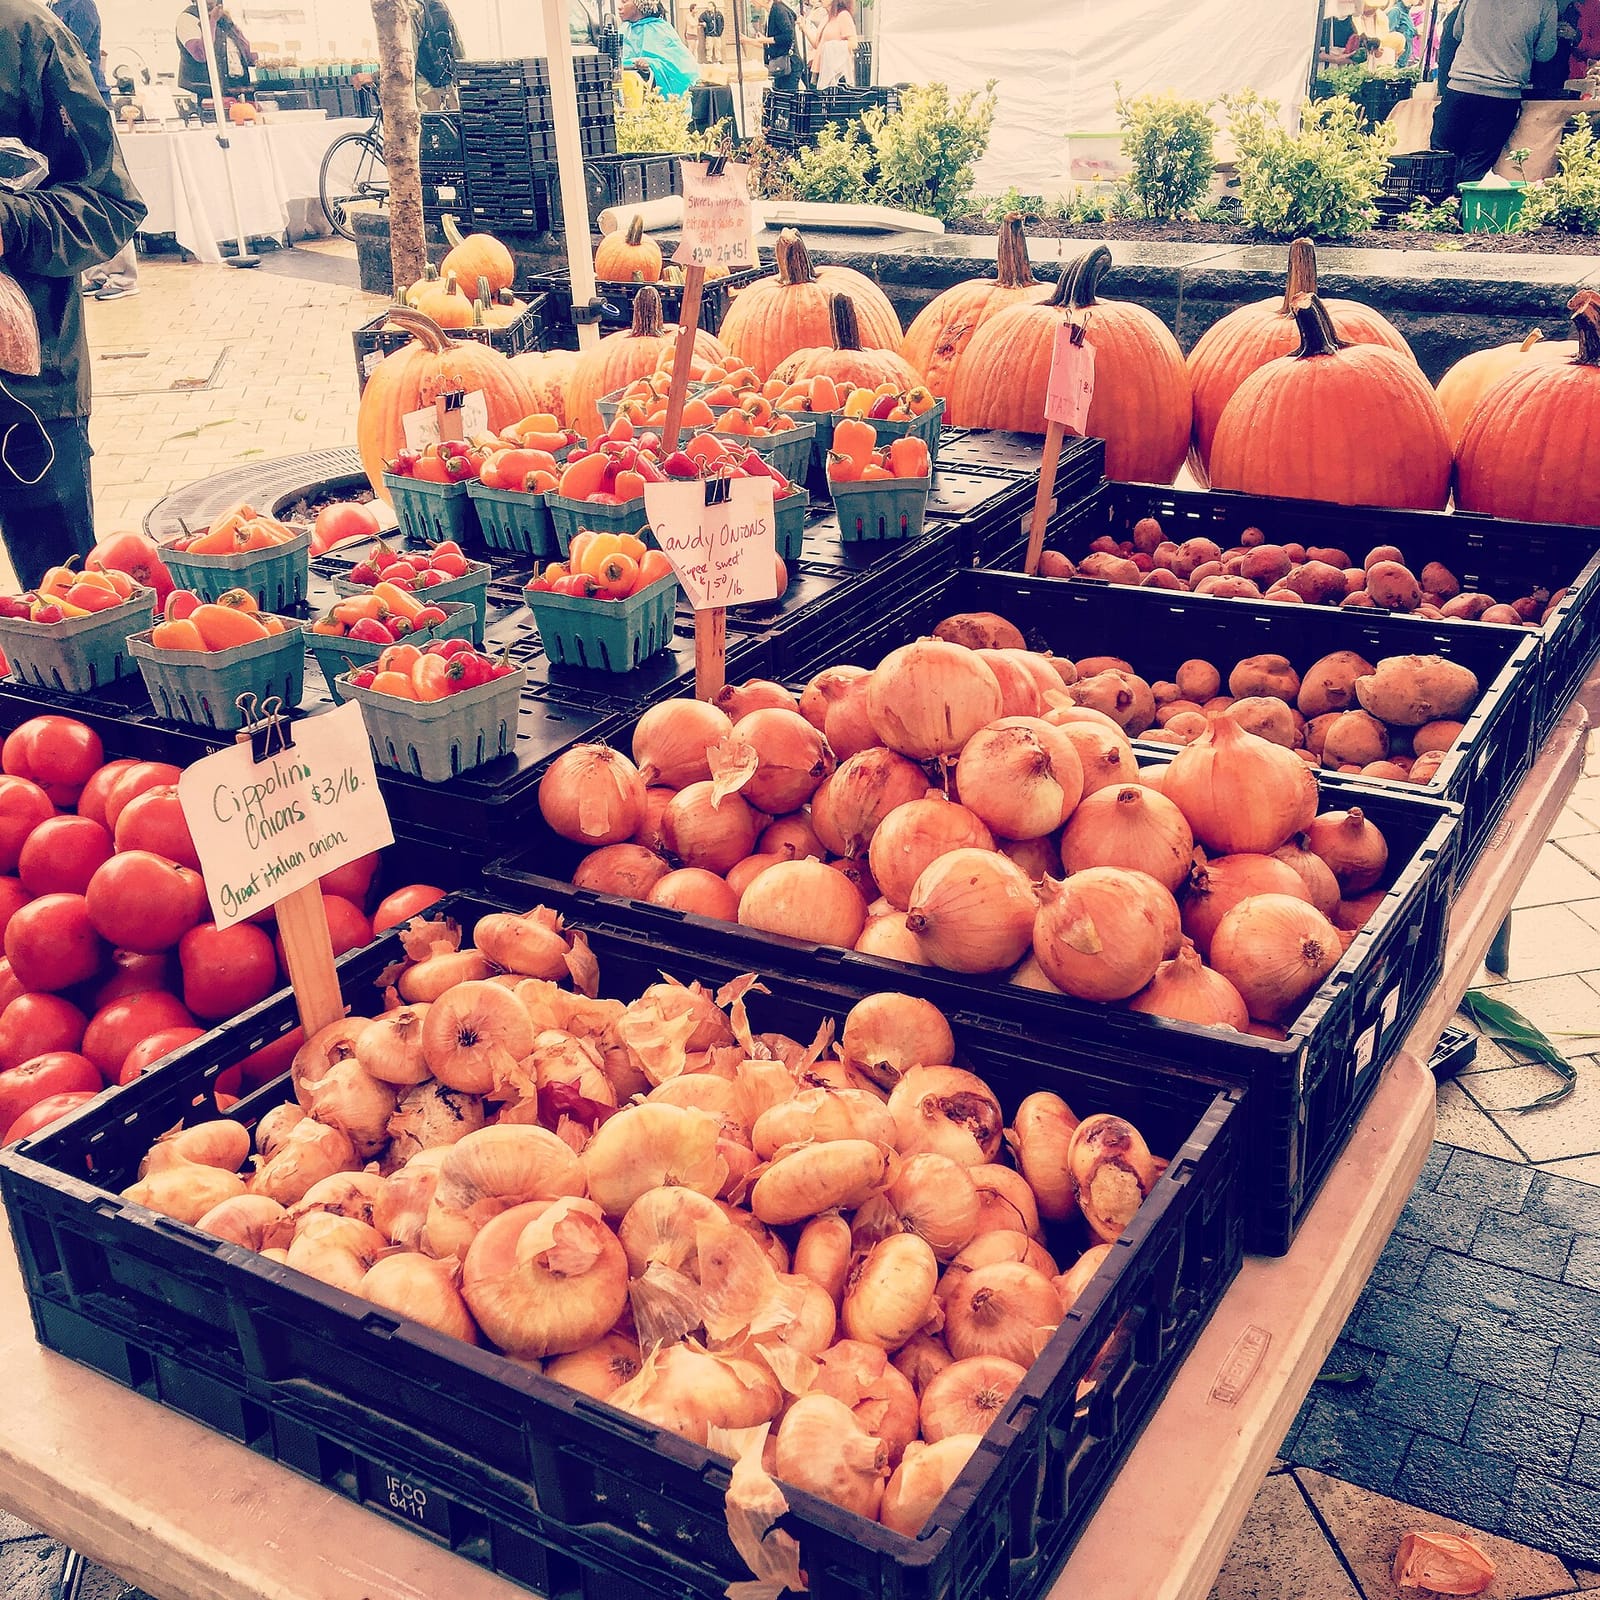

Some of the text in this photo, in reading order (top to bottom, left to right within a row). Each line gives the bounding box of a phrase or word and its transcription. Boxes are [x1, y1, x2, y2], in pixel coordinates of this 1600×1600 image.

[656, 524, 714, 561] Candy
[245, 800, 306, 850] Onions
[309, 831, 348, 858] onion
[386, 1475, 427, 1506] IFCO
[389, 1491, 424, 1519] 6411
